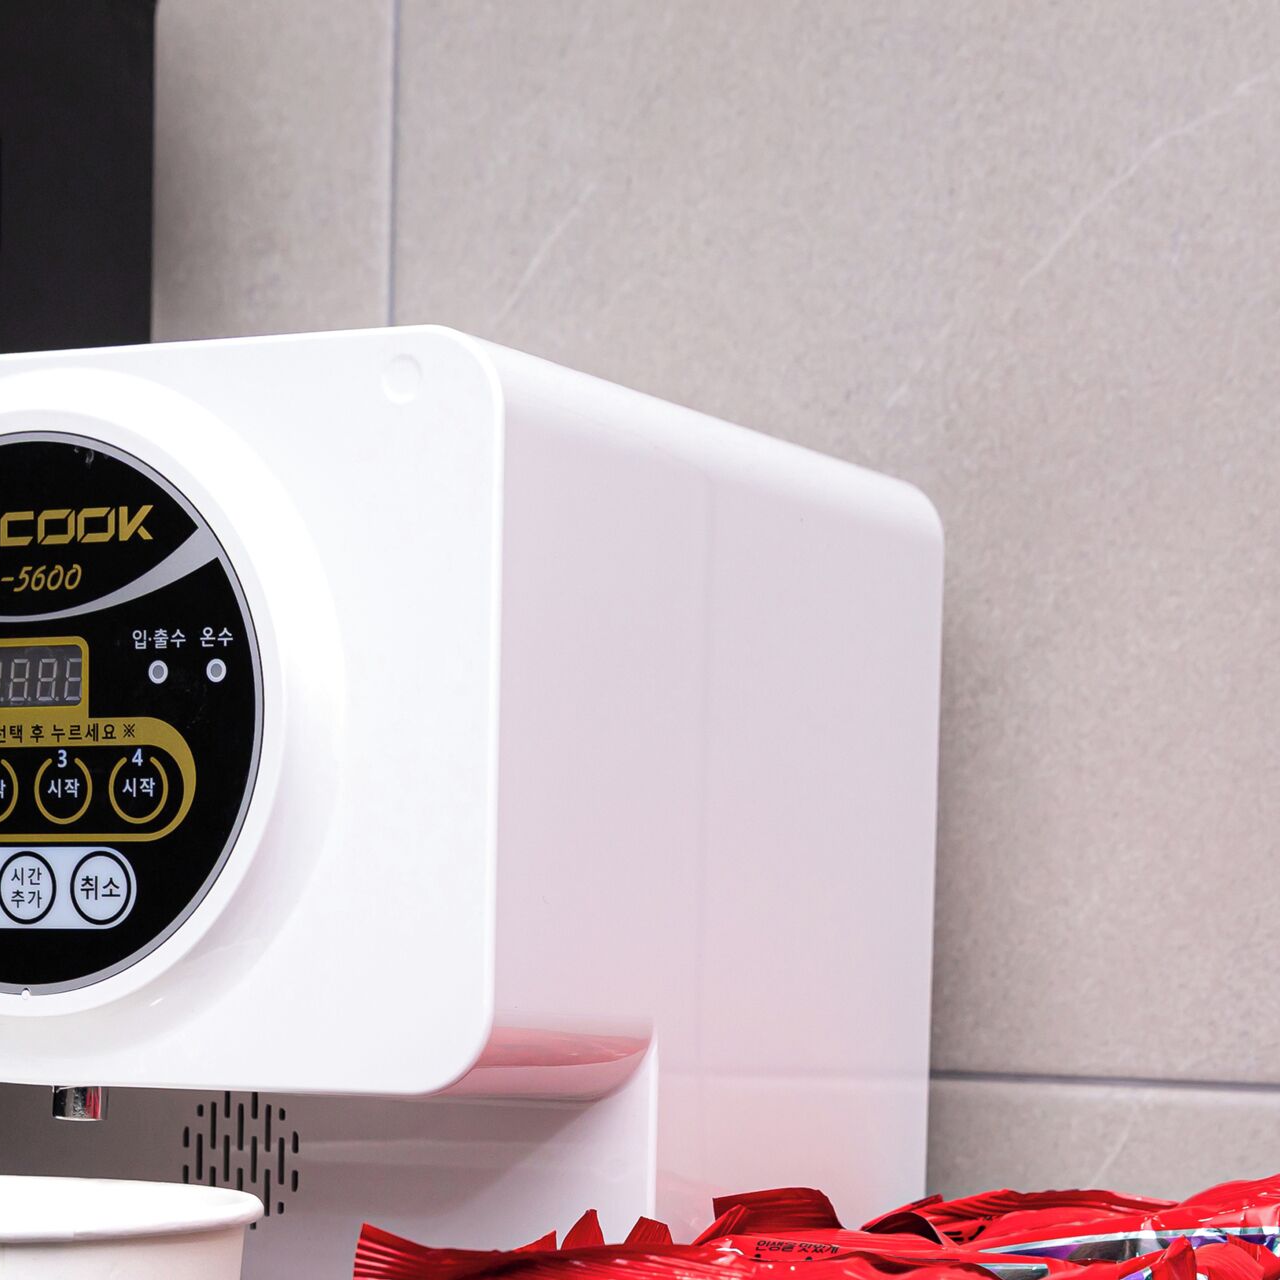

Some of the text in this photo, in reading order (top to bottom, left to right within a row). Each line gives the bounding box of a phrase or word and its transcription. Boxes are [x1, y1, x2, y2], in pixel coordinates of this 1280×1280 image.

[0, 504, 154, 548] COOK
[199, 627, 234, 647] 온수
[30, 724, 44, 742] 후
[50, 722, 117, 742] 누르세요
[57, 749, 68, 768] 3
[131, 748, 143, 767] 4
[47, 778, 80, 798] 시작
[122, 777, 156, 797] 시작
[11, 867, 42, 886] 시간
[80, 875, 121, 901] 취소
[11, 890, 42, 909] 추가
